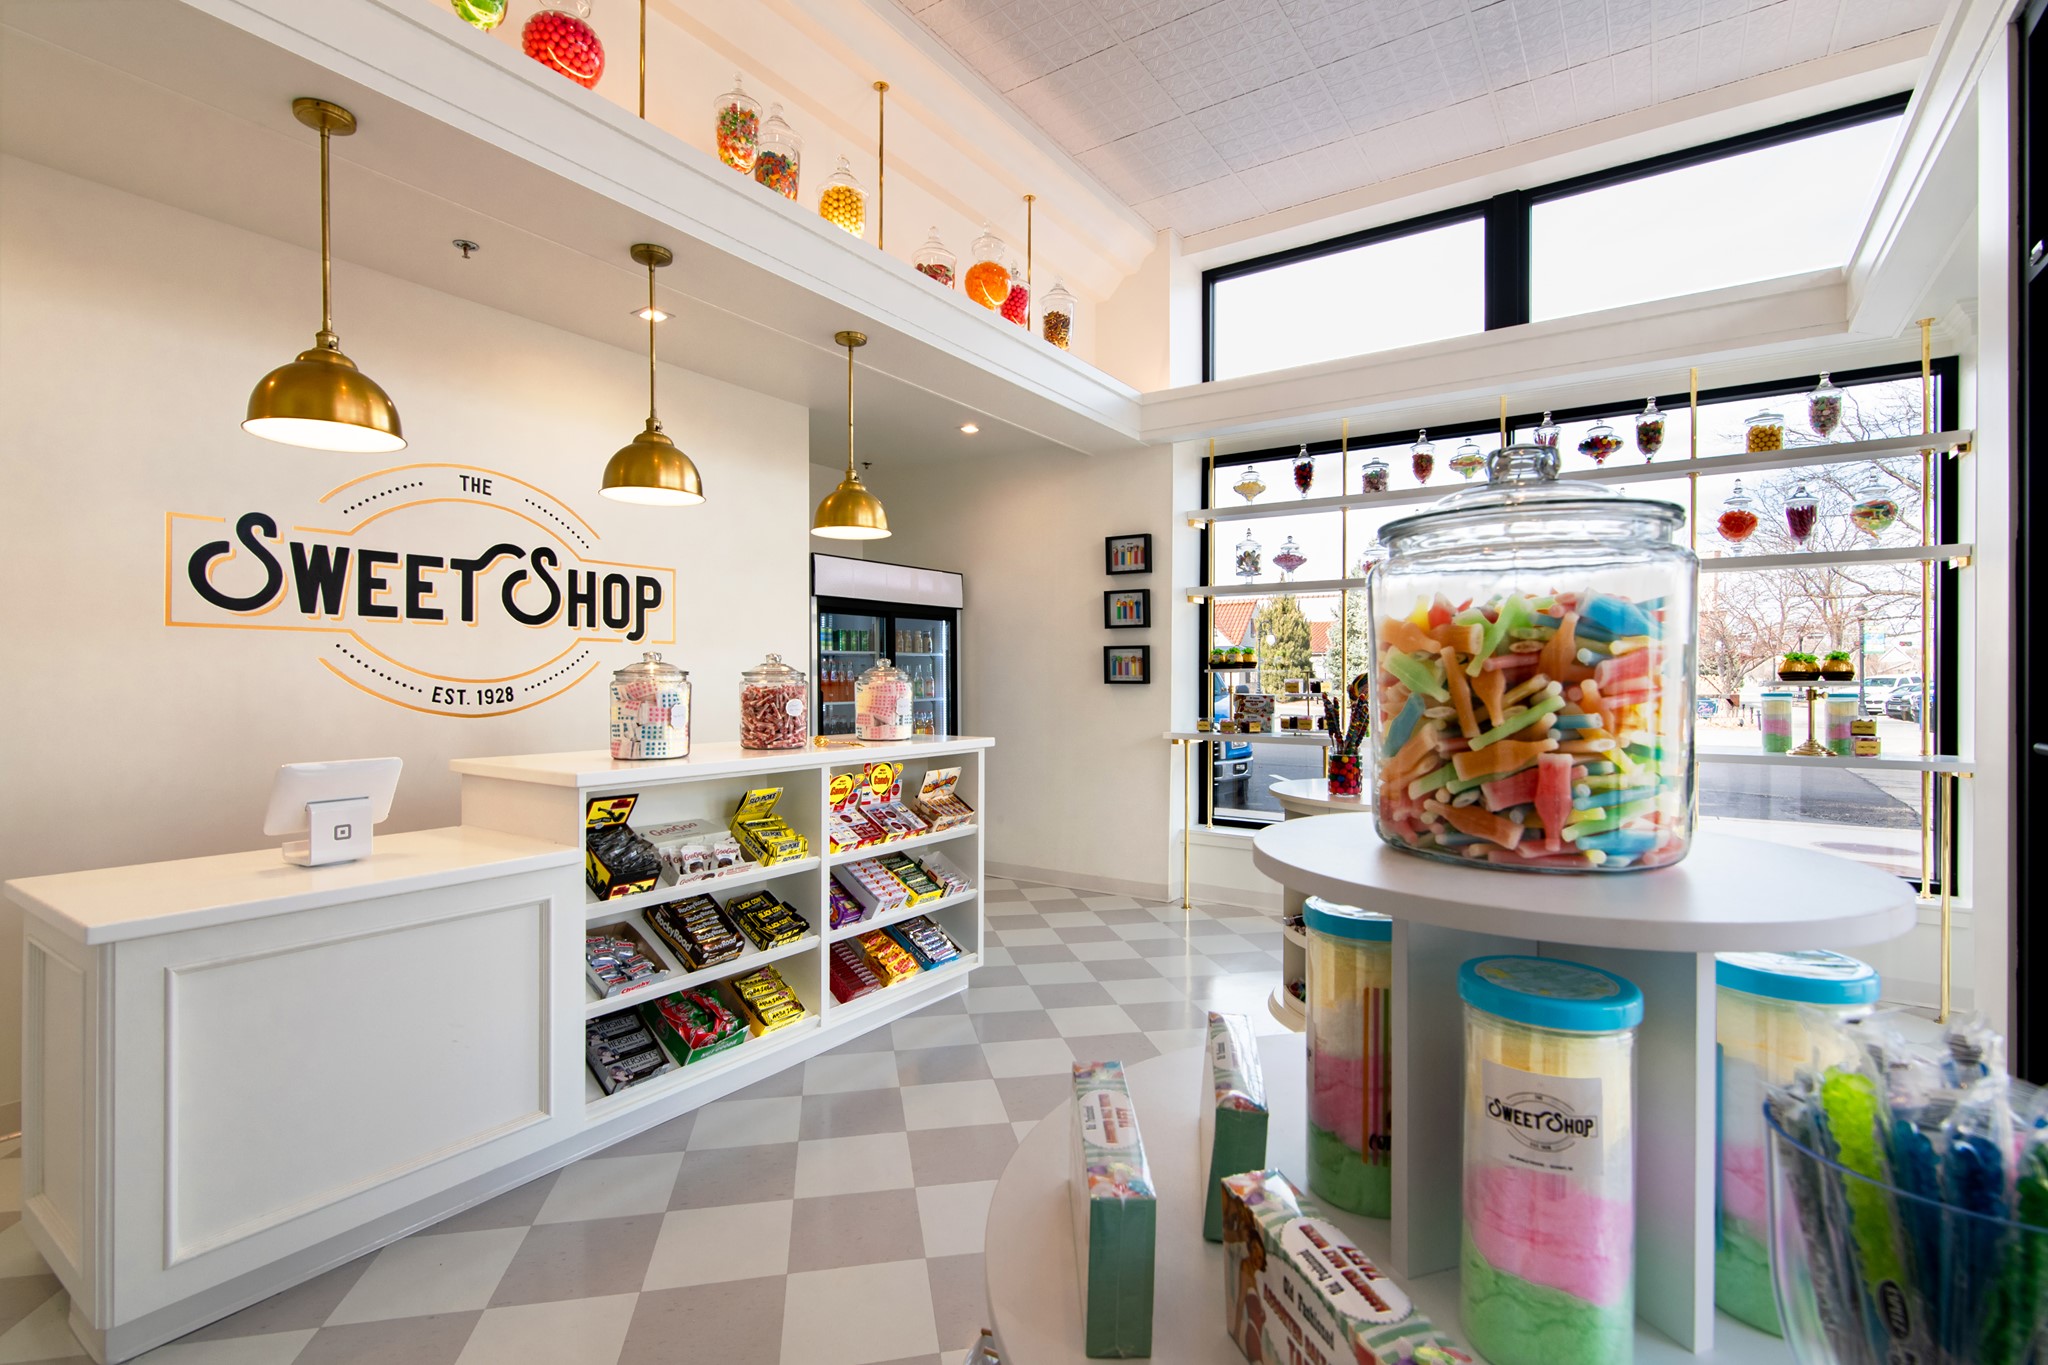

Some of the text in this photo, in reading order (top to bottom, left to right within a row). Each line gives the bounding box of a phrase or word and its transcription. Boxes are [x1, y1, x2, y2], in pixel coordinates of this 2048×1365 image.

[459, 474, 492, 496] THE
[188, 512, 662, 641] SWEET SHOP
[431, 686, 514, 706] EST. 1928
[621, 980, 652, 995] Chunky
[1488, 1097, 1594, 1138] SWEET SHOP
